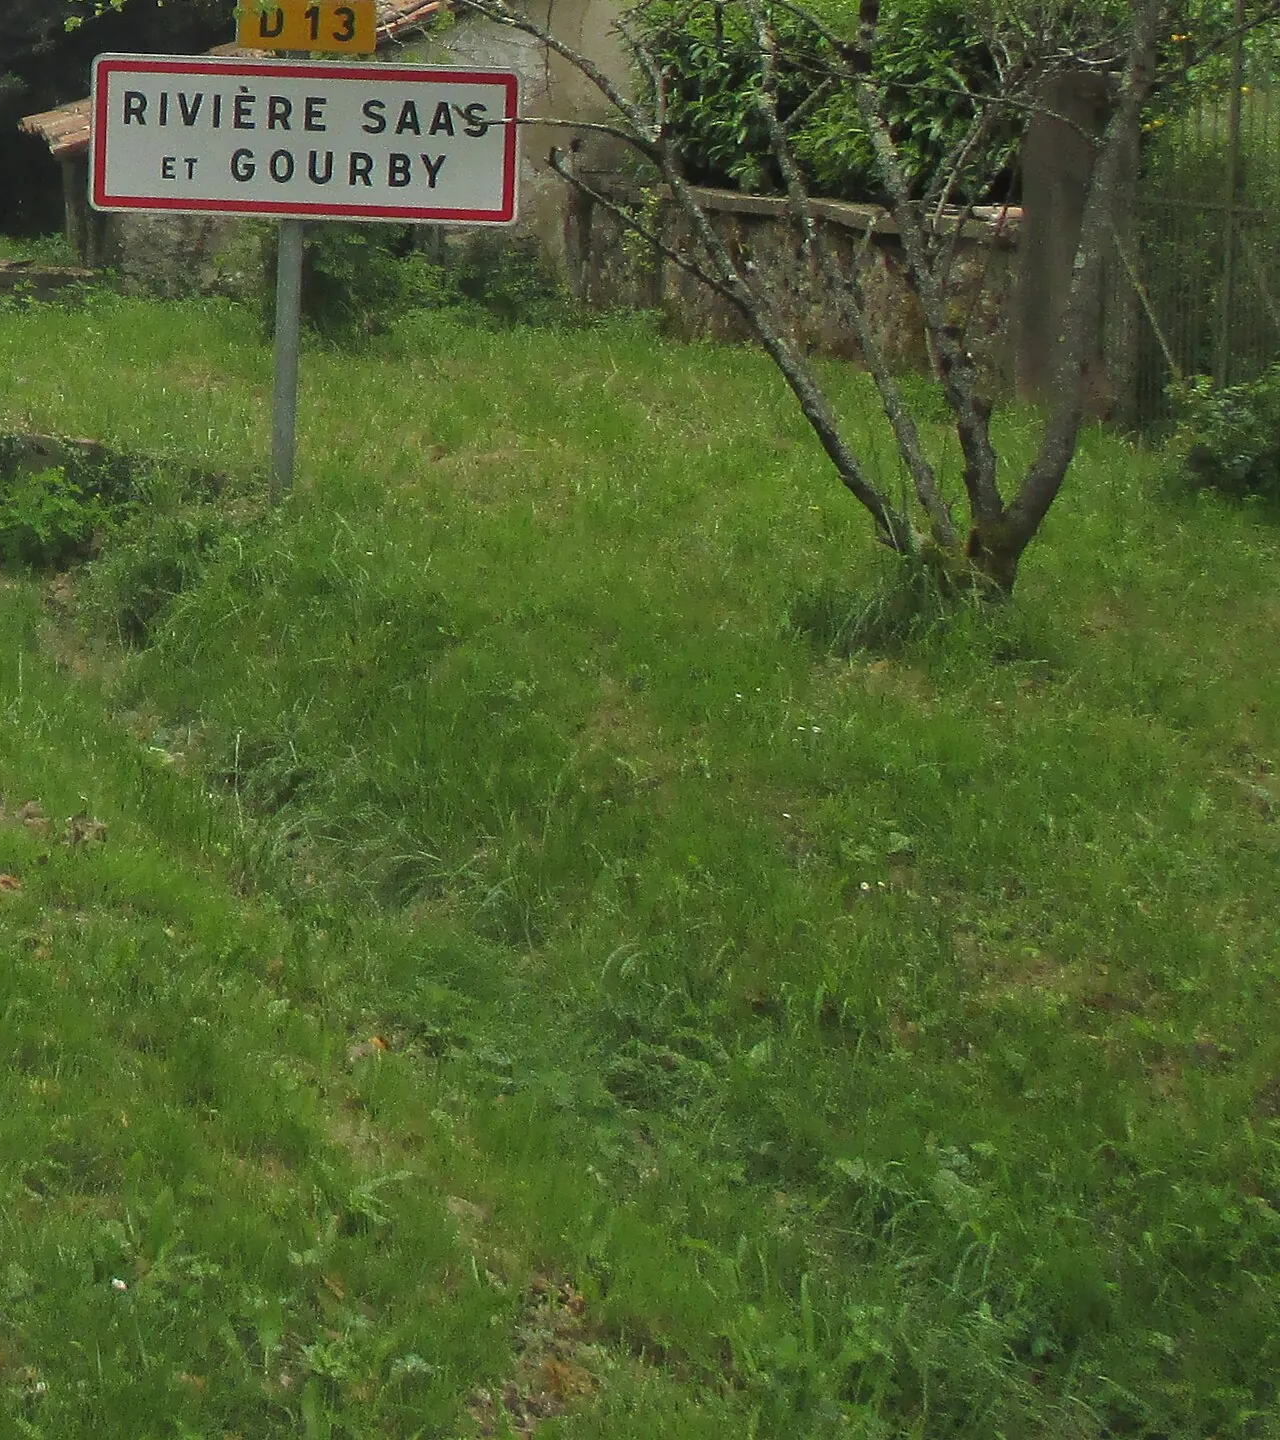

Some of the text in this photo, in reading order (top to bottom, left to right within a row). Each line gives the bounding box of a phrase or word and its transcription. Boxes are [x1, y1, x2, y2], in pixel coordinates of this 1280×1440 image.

[257, 6, 355, 42] D 13
[123, 86, 489, 137] RIVIÈRE SAAS
[161, 148, 446, 188] ET GOURBY
